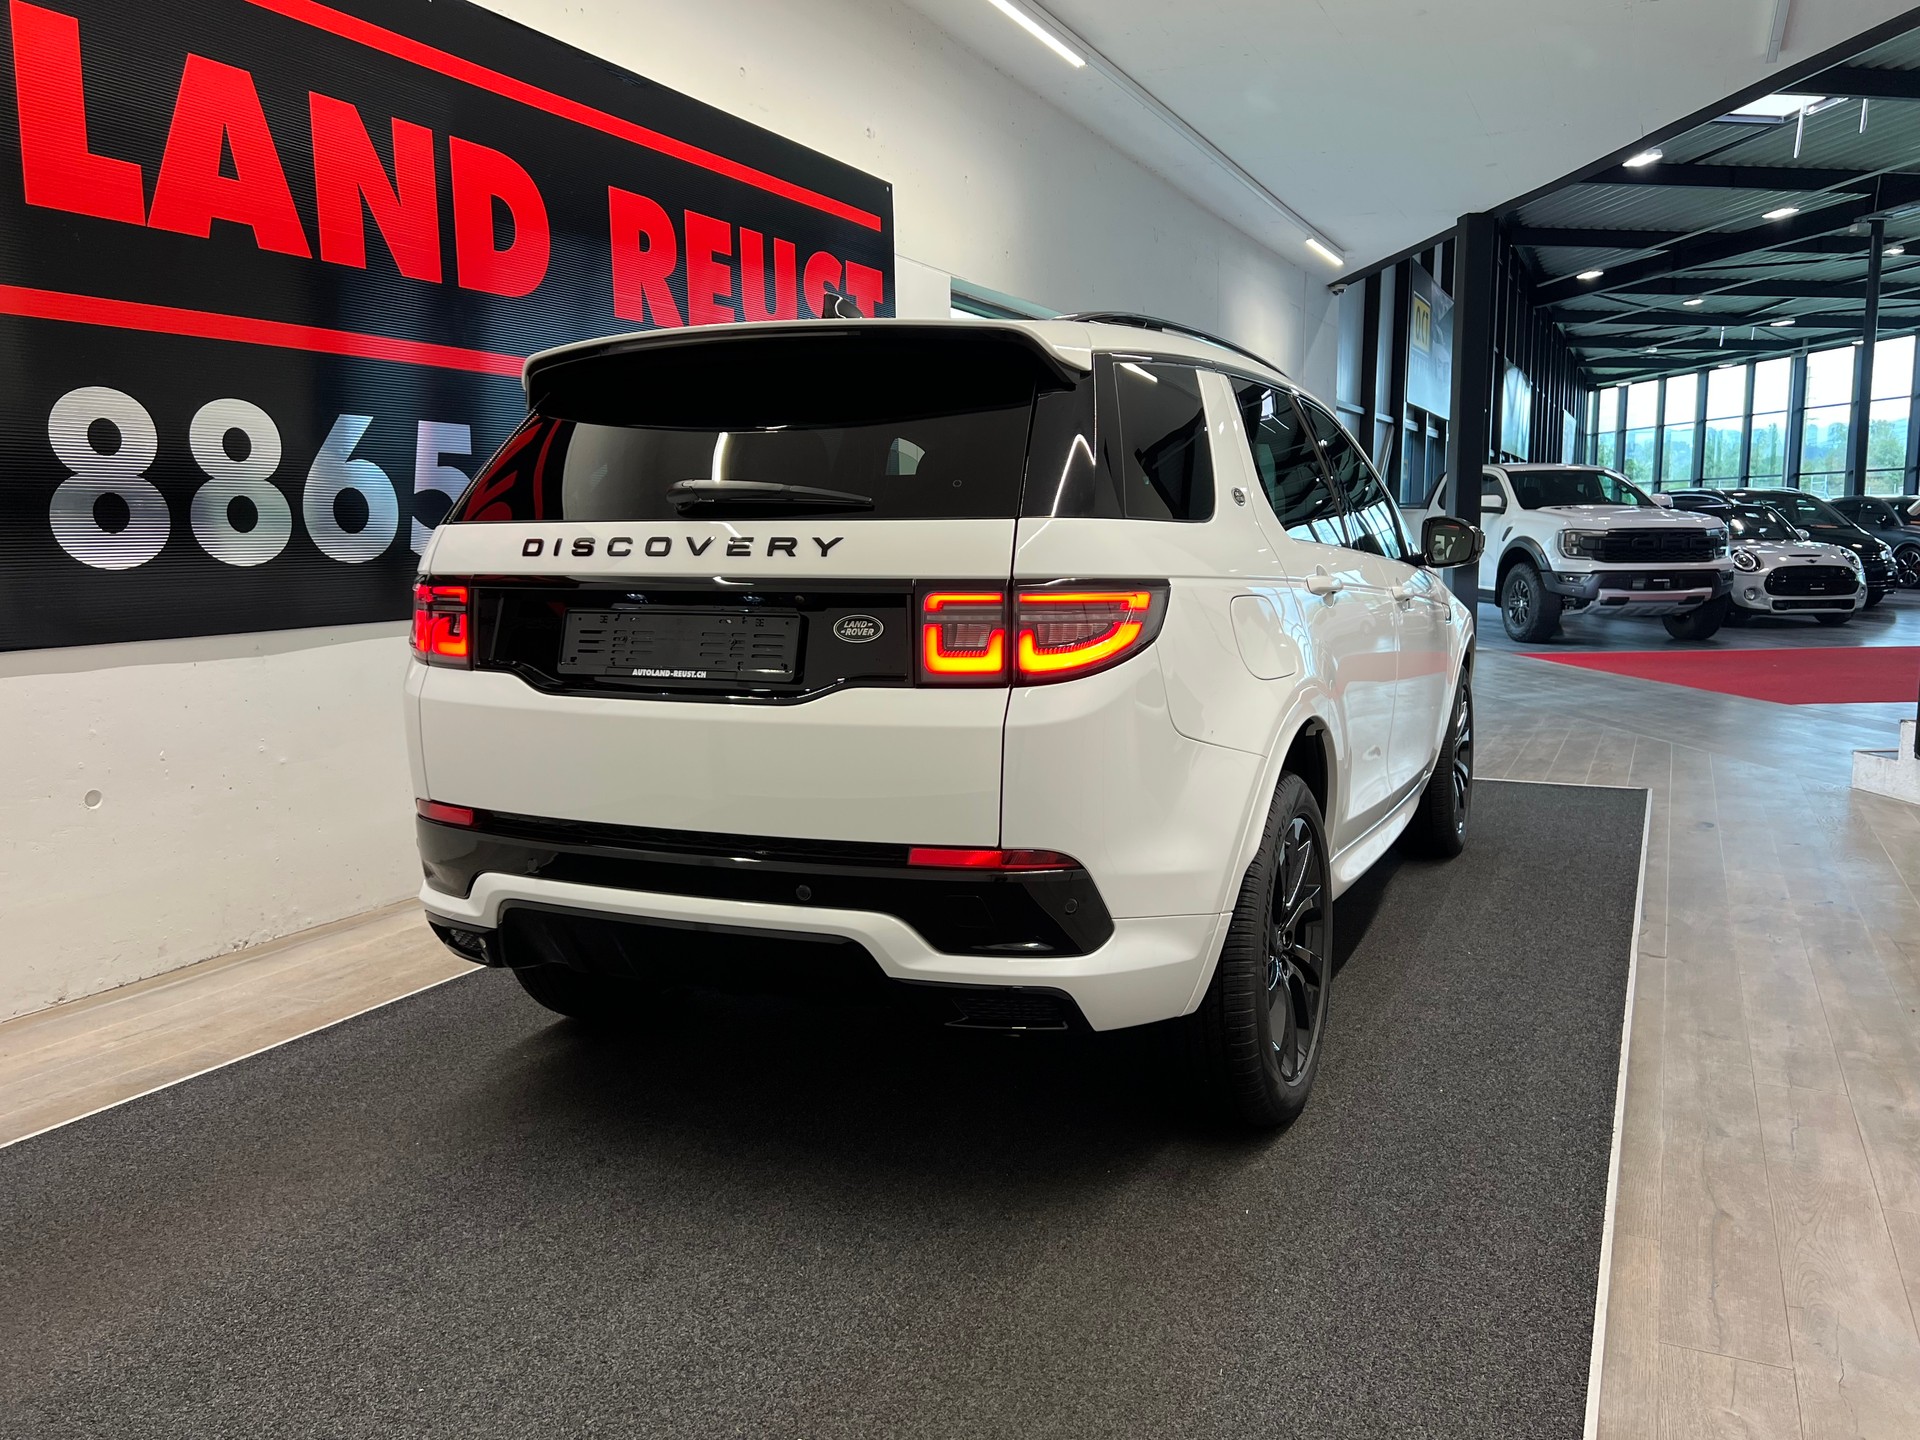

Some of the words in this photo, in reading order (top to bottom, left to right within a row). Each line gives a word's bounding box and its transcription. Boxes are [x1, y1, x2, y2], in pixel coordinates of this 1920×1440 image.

[10, 0, 551, 298] LAND
[48, 386, 473, 570] 8865
[521, 537, 844, 558] DISCOVERY
[843, 620, 868, 628] LAND
[844, 628, 875, 636] ROVER
[632, 668, 707, 679] AUTOLAND-REUST.CH
